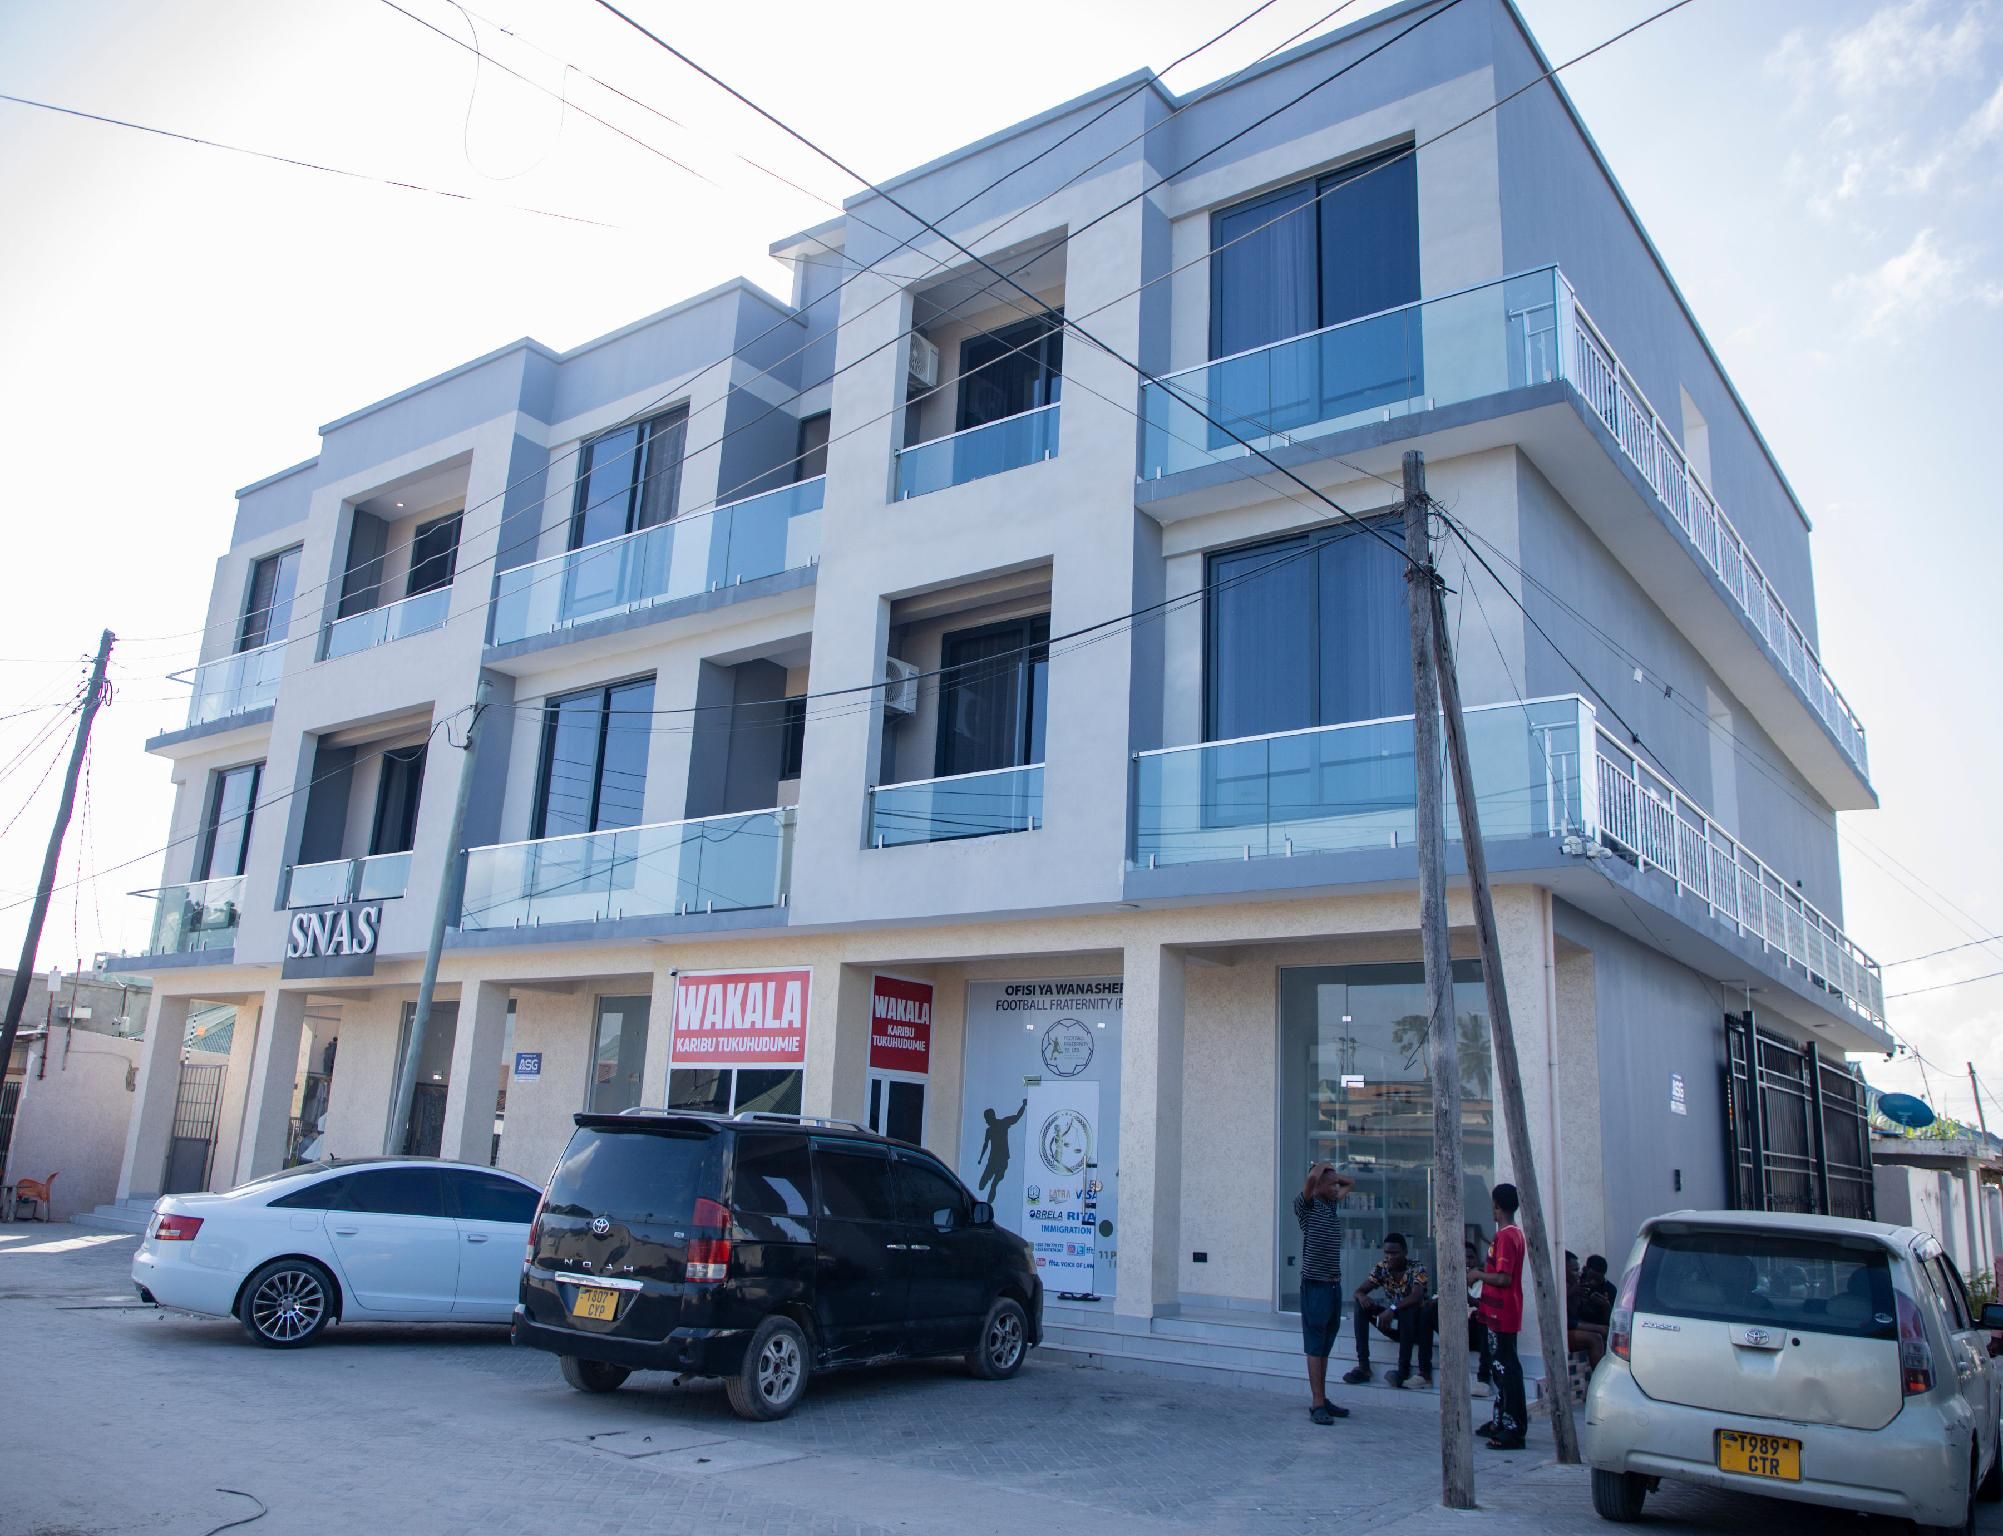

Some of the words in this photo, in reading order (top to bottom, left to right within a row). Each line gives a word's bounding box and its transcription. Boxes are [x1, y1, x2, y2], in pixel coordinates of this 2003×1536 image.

[287, 906, 379, 958] SNAS
[1005, 984, 1036, 996] OFISI
[1038, 984, 1053, 996] YA
[678, 981, 802, 1031] WAKALA
[874, 995, 930, 1025] WAKALA
[996, 999, 1048, 1011] FOOTBALL
[1050, 998, 1112, 1011] FRATERNITY
[887, 1024, 915, 1038] KARIBU
[676, 1036, 716, 1053] KARIBU
[718, 1036, 800, 1053] TUKUHUDUMIE
[873, 1035, 926, 1052] TUKUHUDUMIE
[519, 1059, 538, 1071] ASG
[1075, 1189, 1097, 1200] VSA
[1036, 1210, 1063, 1219] BRELA
[1067, 1211, 1096, 1221] RITA
[1041, 1224, 1092, 1235] IMMIGRATION
[564, 1258, 634, 1273] NOAH
[588, 1303, 605, 1317] CYP
[1738, 1435, 1780, 1456] T989
[1748, 1455, 1780, 1476] CTR
